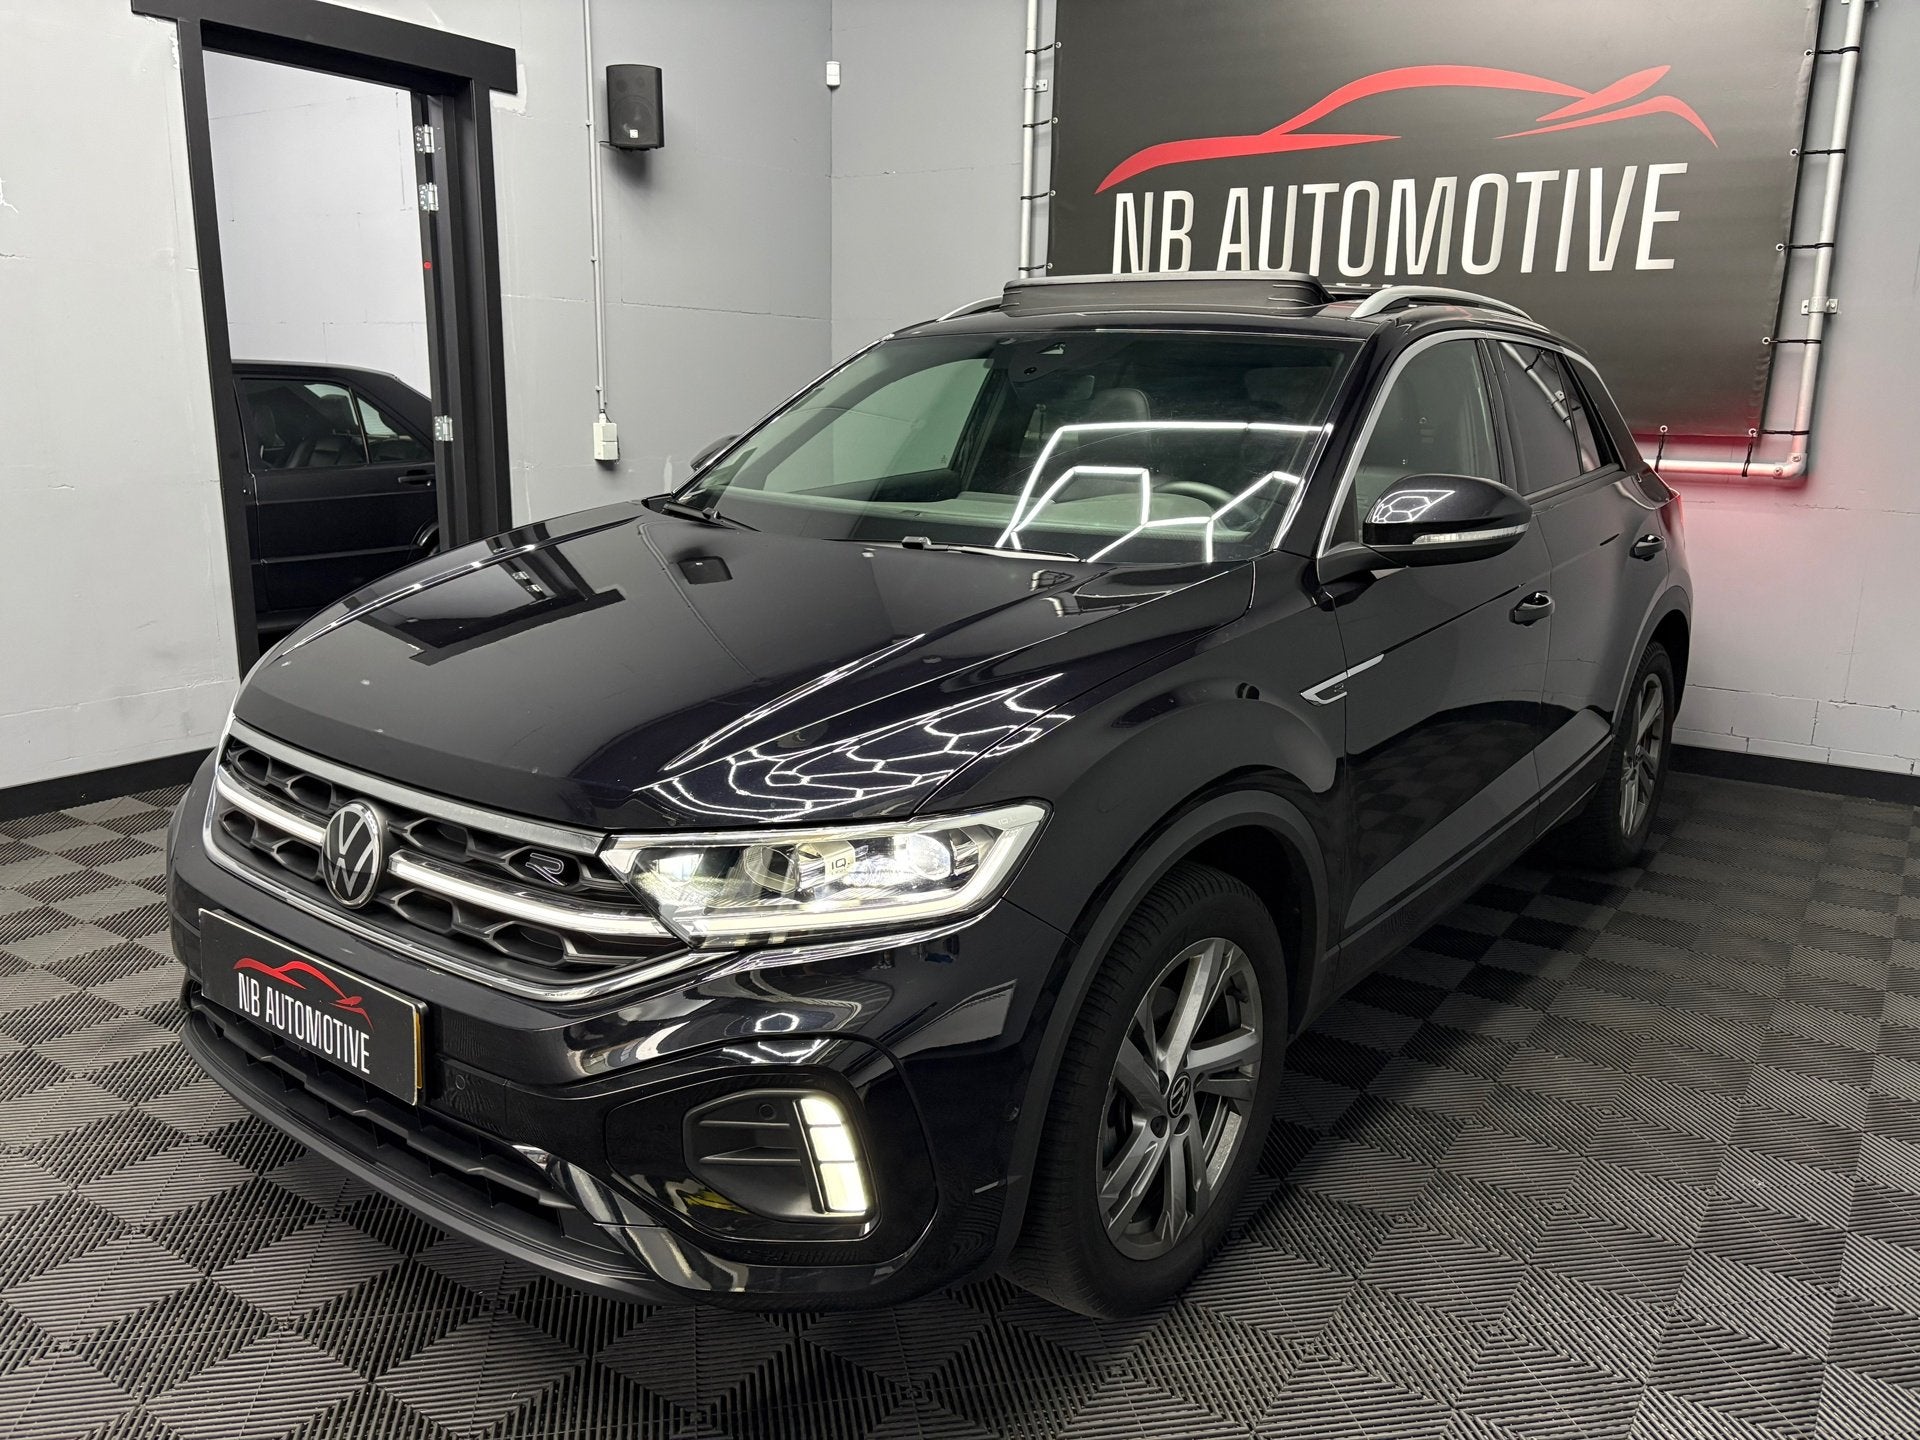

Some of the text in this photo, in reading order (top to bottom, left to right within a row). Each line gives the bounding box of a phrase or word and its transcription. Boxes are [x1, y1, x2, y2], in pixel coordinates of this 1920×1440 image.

[1112, 163, 1689, 277] NB AUTOMOTIVE
[525, 852, 566, 887] R
[238, 973, 371, 1075] NB AUTOMOTIVE
